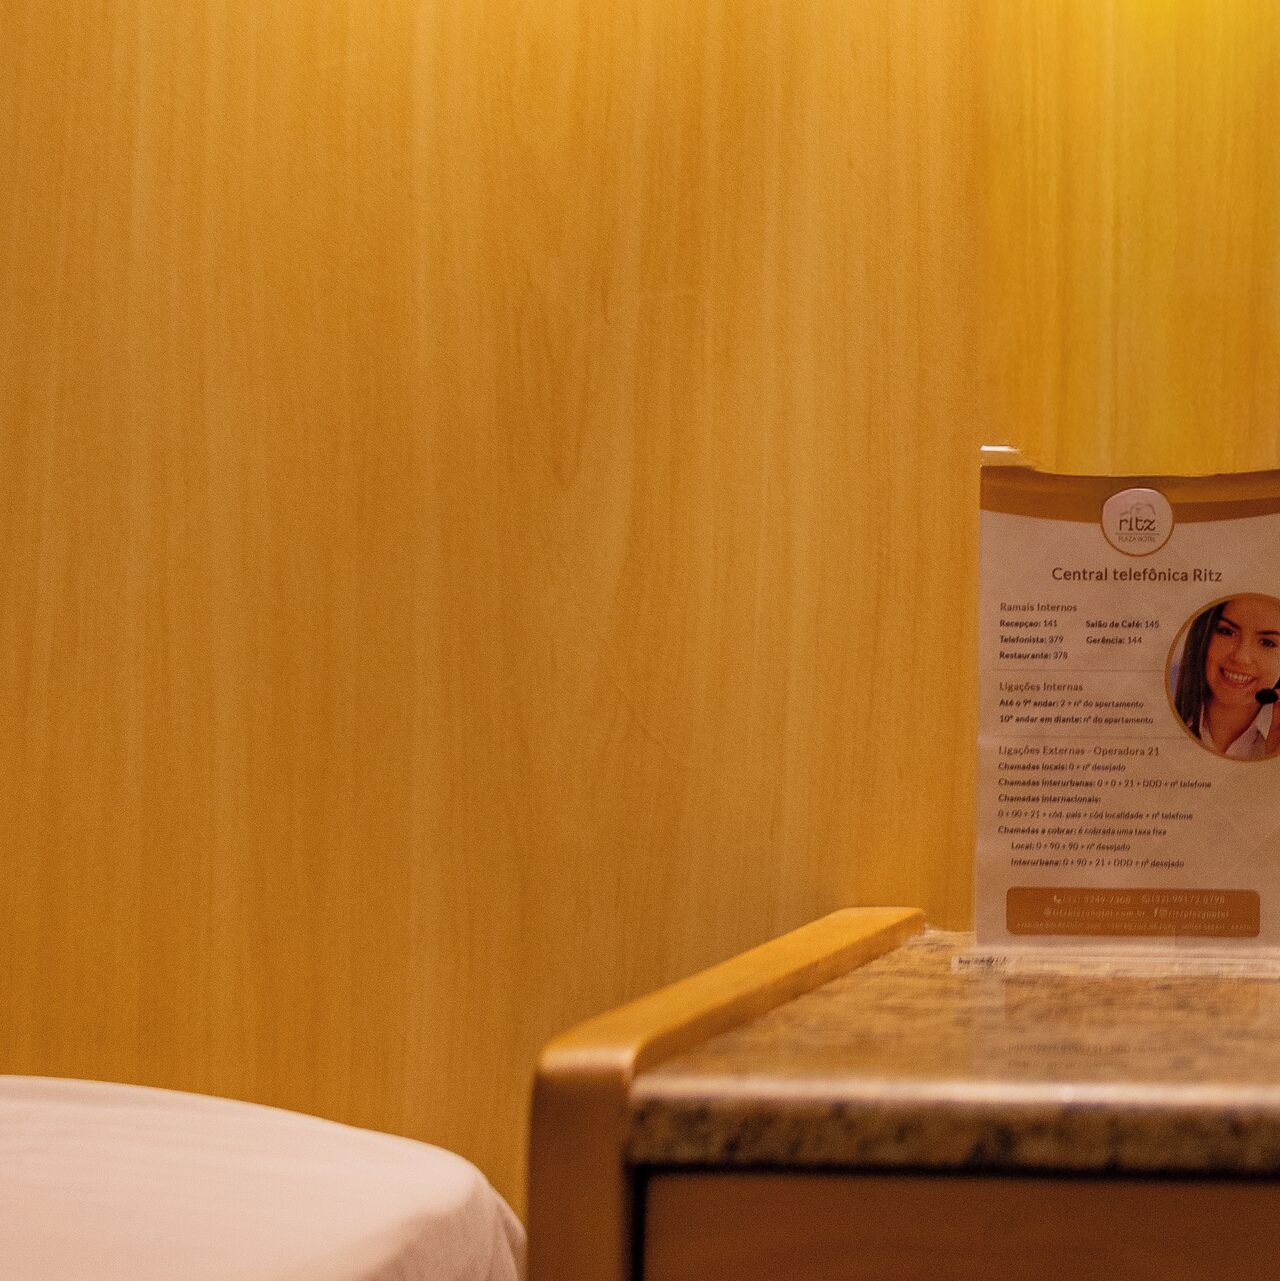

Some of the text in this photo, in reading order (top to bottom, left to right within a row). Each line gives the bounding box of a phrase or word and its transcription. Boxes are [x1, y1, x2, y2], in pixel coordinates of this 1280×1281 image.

[1119, 516, 1156, 531] ritz
[1052, 567, 1222, 582] Central telefônica Ritz
[1000, 602, 1077, 612] Ramais Internos
[1043, 620, 1057, 628] 141
[1086, 620, 1159, 629] Salão de Café: 145
[1000, 635, 1064, 644] Telefonista: 379
[1086, 636, 1142, 645] Gerência: 144
[999, 651, 1068, 660] Restaurante: 378
[999, 681, 1084, 693] Ligações Internas
[1083, 699, 1093, 709] do
[1095, 700, 1144, 710] apartamento
[1015, 715, 1038, 723] andar
[1092, 715, 1103, 724] do
[1104, 716, 1154, 727] apartamento
[999, 745, 1159, 757] Ligações Externas Operadora 21
[998, 762, 1040, 771] Chamadas
[1092, 763, 1126, 773] desejado
[998, 778, 1040, 787] Chamadas
[1124, 779, 1134, 788] 21
[1180, 780, 1212, 789] telefone
[998, 794, 1040, 803] Chamadas
[1030, 810, 1040, 819] 21
[1161, 812, 1193, 821] telefone
[998, 825, 1039, 835] Chamadas
[1096, 843, 1131, 853] desejado
[1095, 858, 1105, 867] 21
[1150, 859, 1185, 870] desejado
